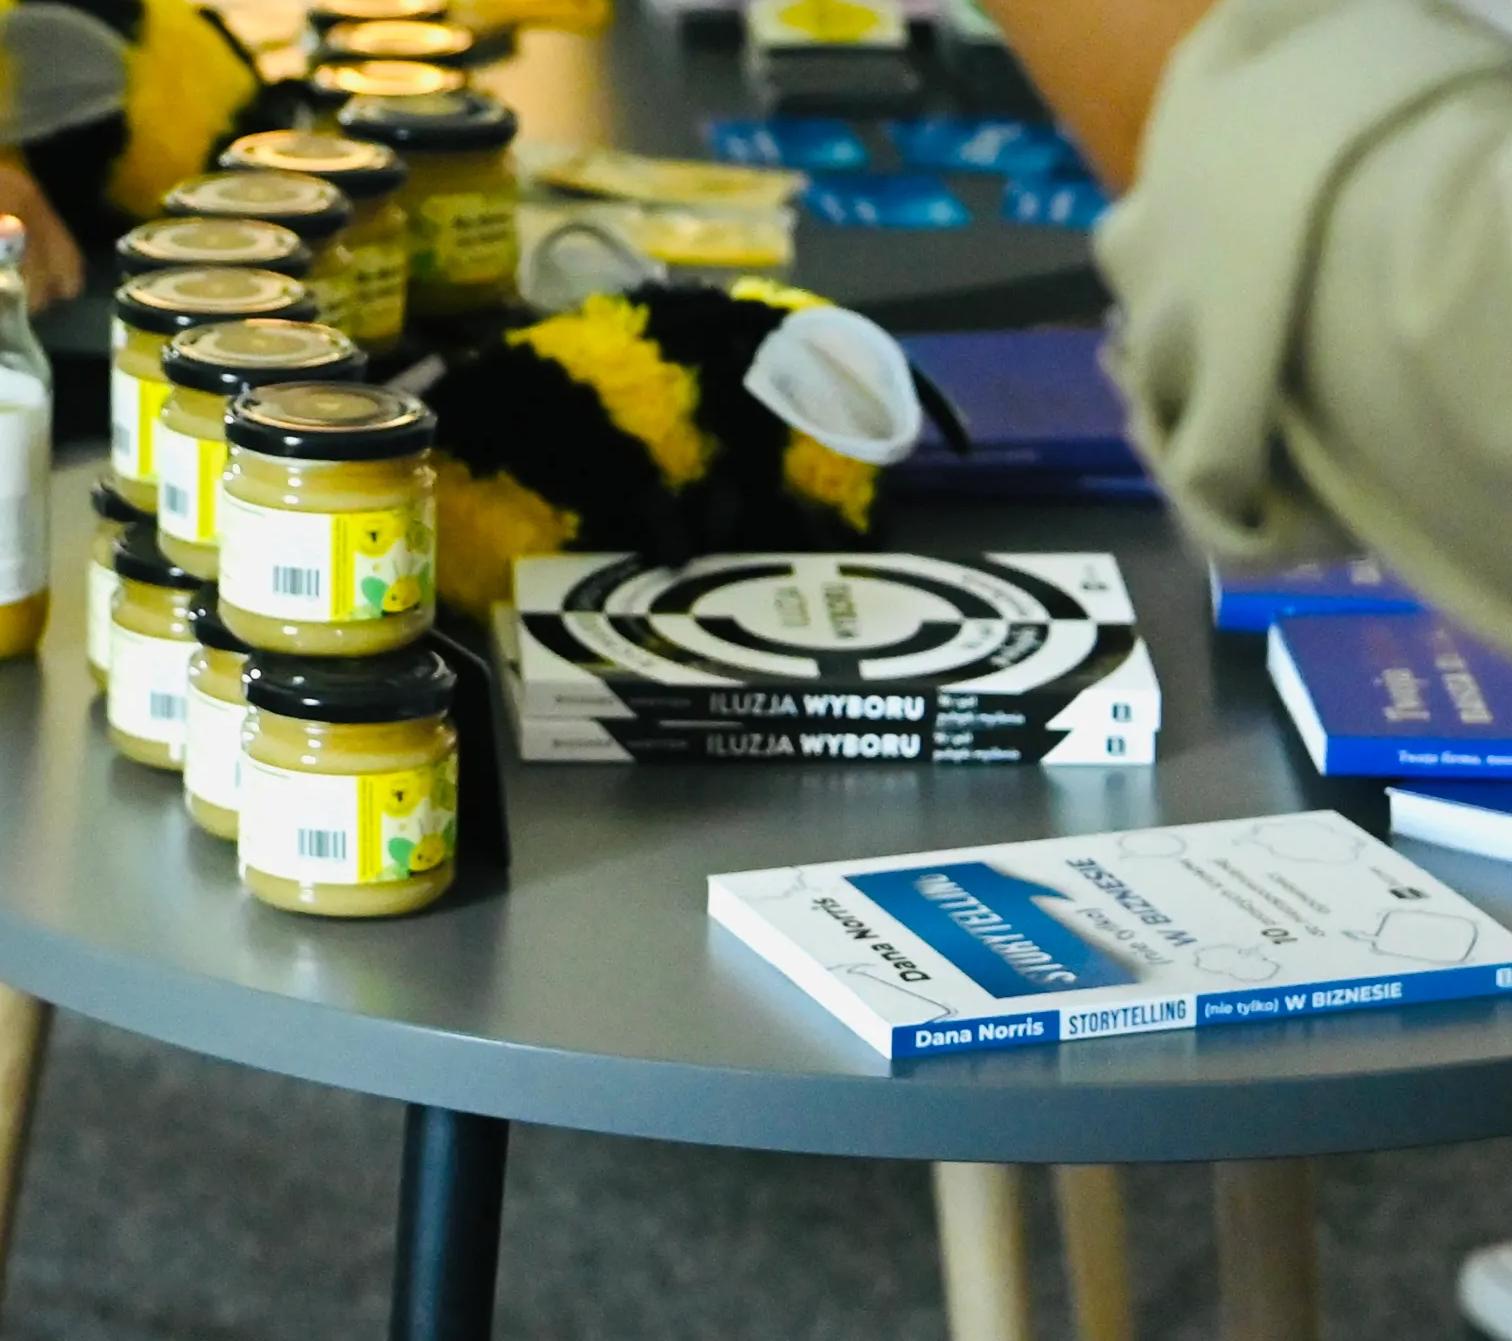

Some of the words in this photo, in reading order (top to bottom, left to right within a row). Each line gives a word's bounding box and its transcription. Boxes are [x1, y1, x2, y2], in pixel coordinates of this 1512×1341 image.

[709, 693, 798, 716] ILUZJA
[803, 693, 925, 720] WYBORU
[706, 733, 796, 757] ILUZJA
[800, 733, 921, 758] WYBORU
[1066, 856, 1173, 925] BIZNESIE
[812, 896, 877, 941] Norris
[1163, 925, 1198, 947] W
[1261, 927, 1298, 945] 10
[875, 942, 932, 983] Dana
[915, 1026, 973, 1048] Dana
[977, 1017, 1045, 1041] Norris
[1069, 1000, 1187, 1035] STORYTELLING
[1204, 1000, 1234, 1018] (nie
[1236, 997, 1280, 1017] tylko)
[1285, 994, 1307, 1011] W
[1312, 982, 1403, 1008] BIZNESIE
